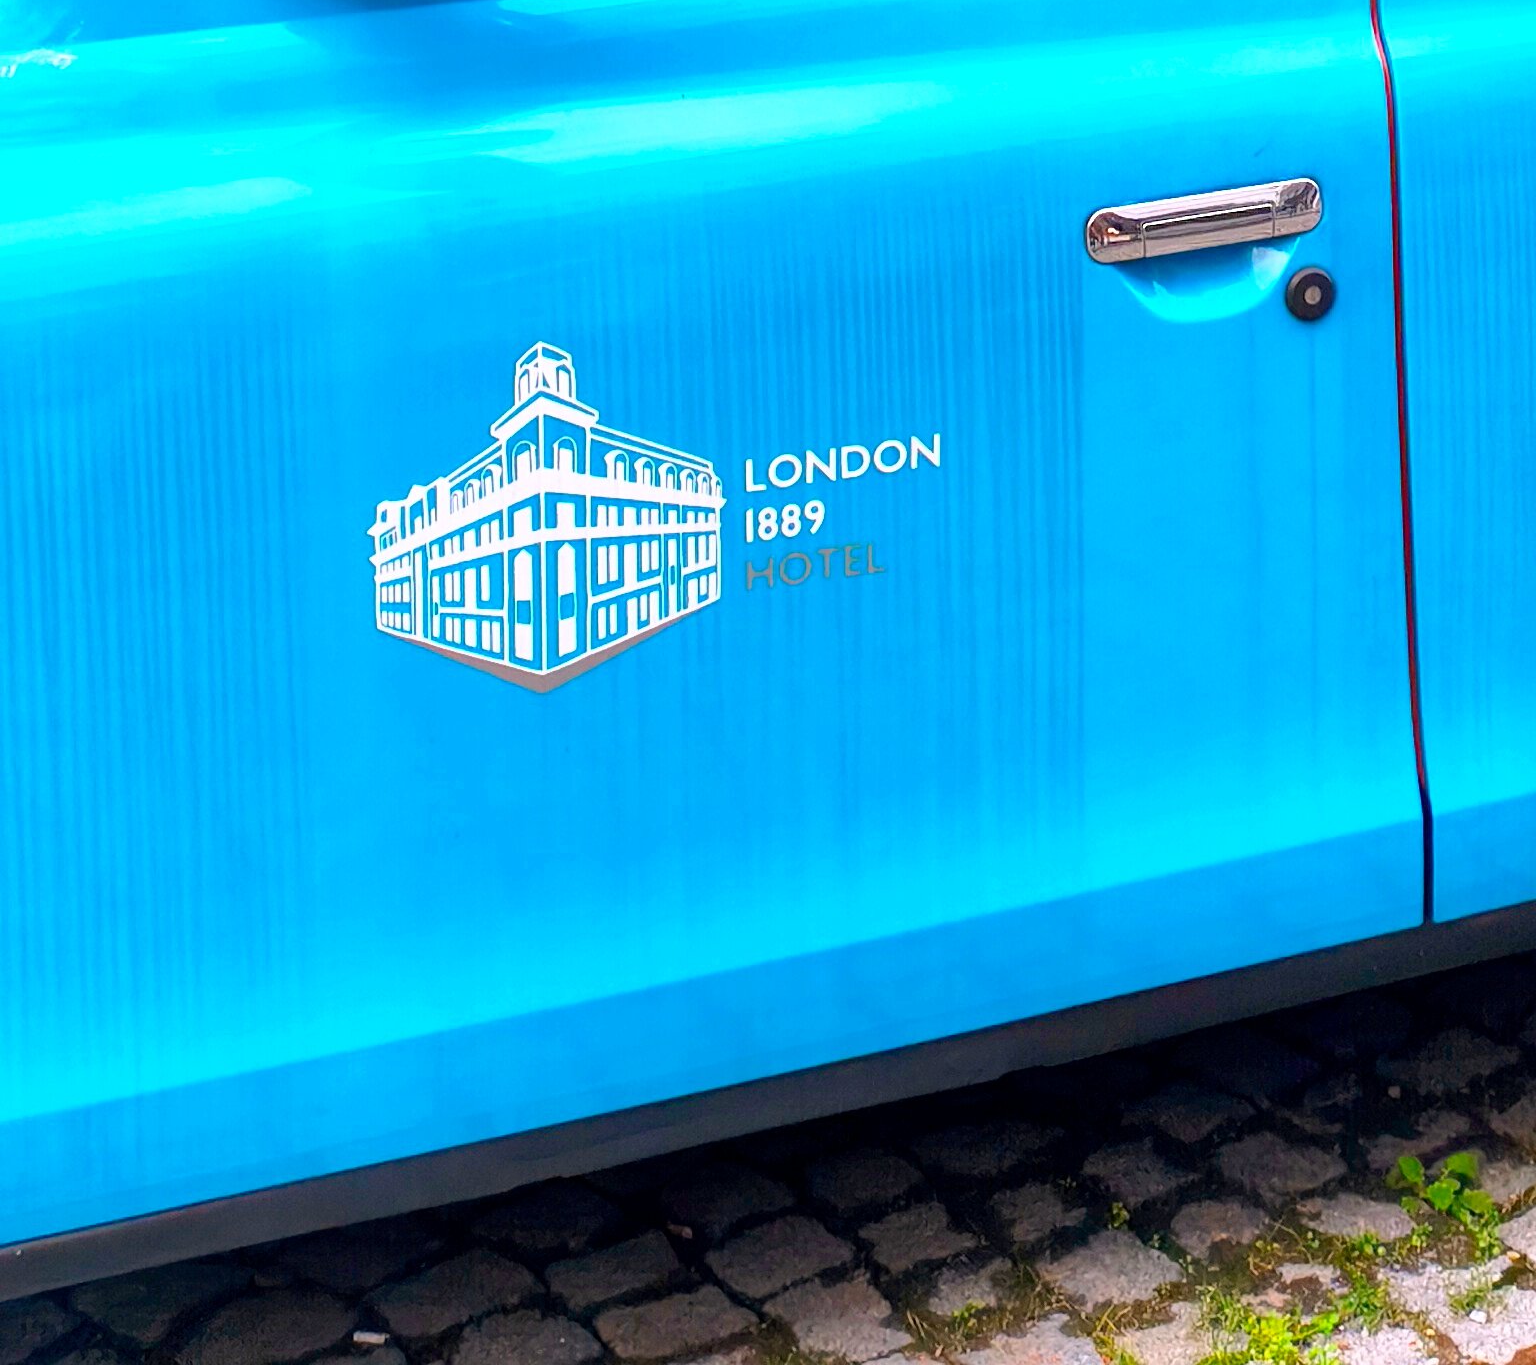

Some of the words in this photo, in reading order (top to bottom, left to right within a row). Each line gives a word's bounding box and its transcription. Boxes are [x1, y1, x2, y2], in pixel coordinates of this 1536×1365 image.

[745, 433, 941, 493] LONDON
[745, 499, 826, 543] 1889
[746, 544, 886, 590] HOTEL
